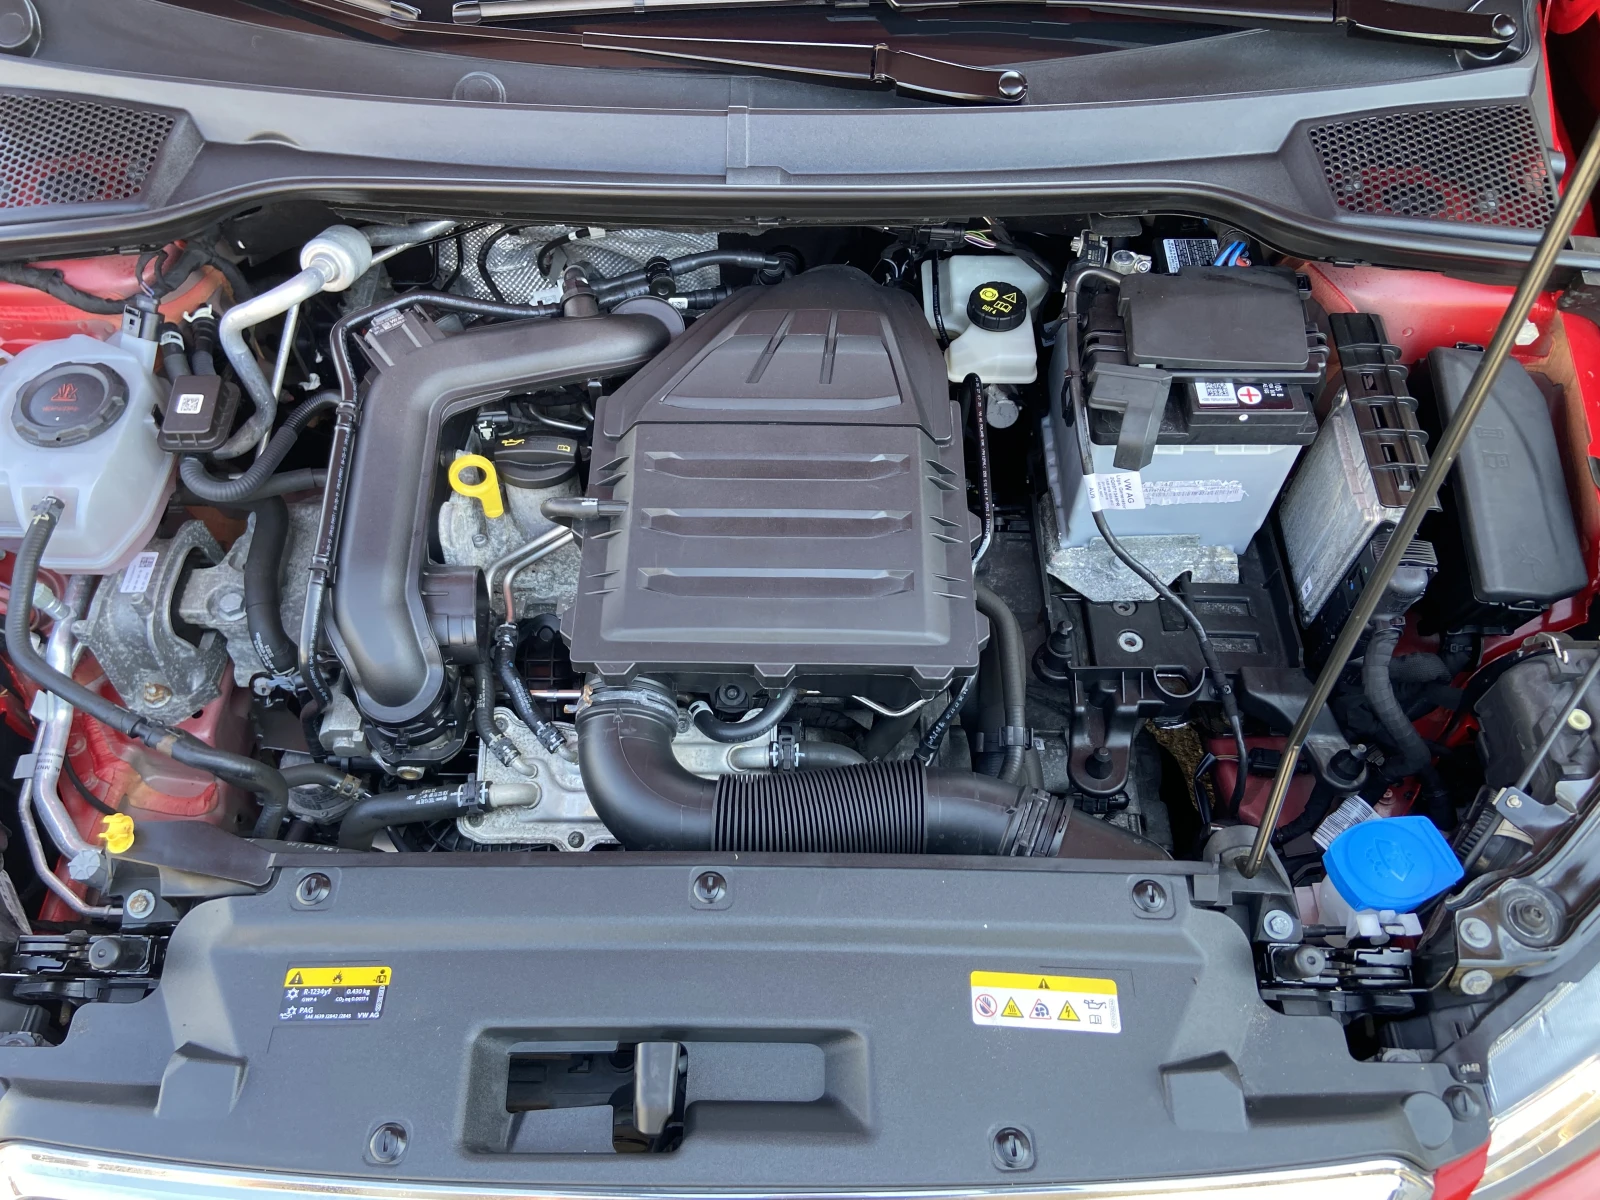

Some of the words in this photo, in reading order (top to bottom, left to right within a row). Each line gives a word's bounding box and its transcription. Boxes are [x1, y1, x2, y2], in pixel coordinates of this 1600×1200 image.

[981, 304, 994, 312] DOT
[1124, 478, 1132, 491] VW
[1126, 492, 1134, 504] AG
[303, 988, 332, 996] R-1234yf
